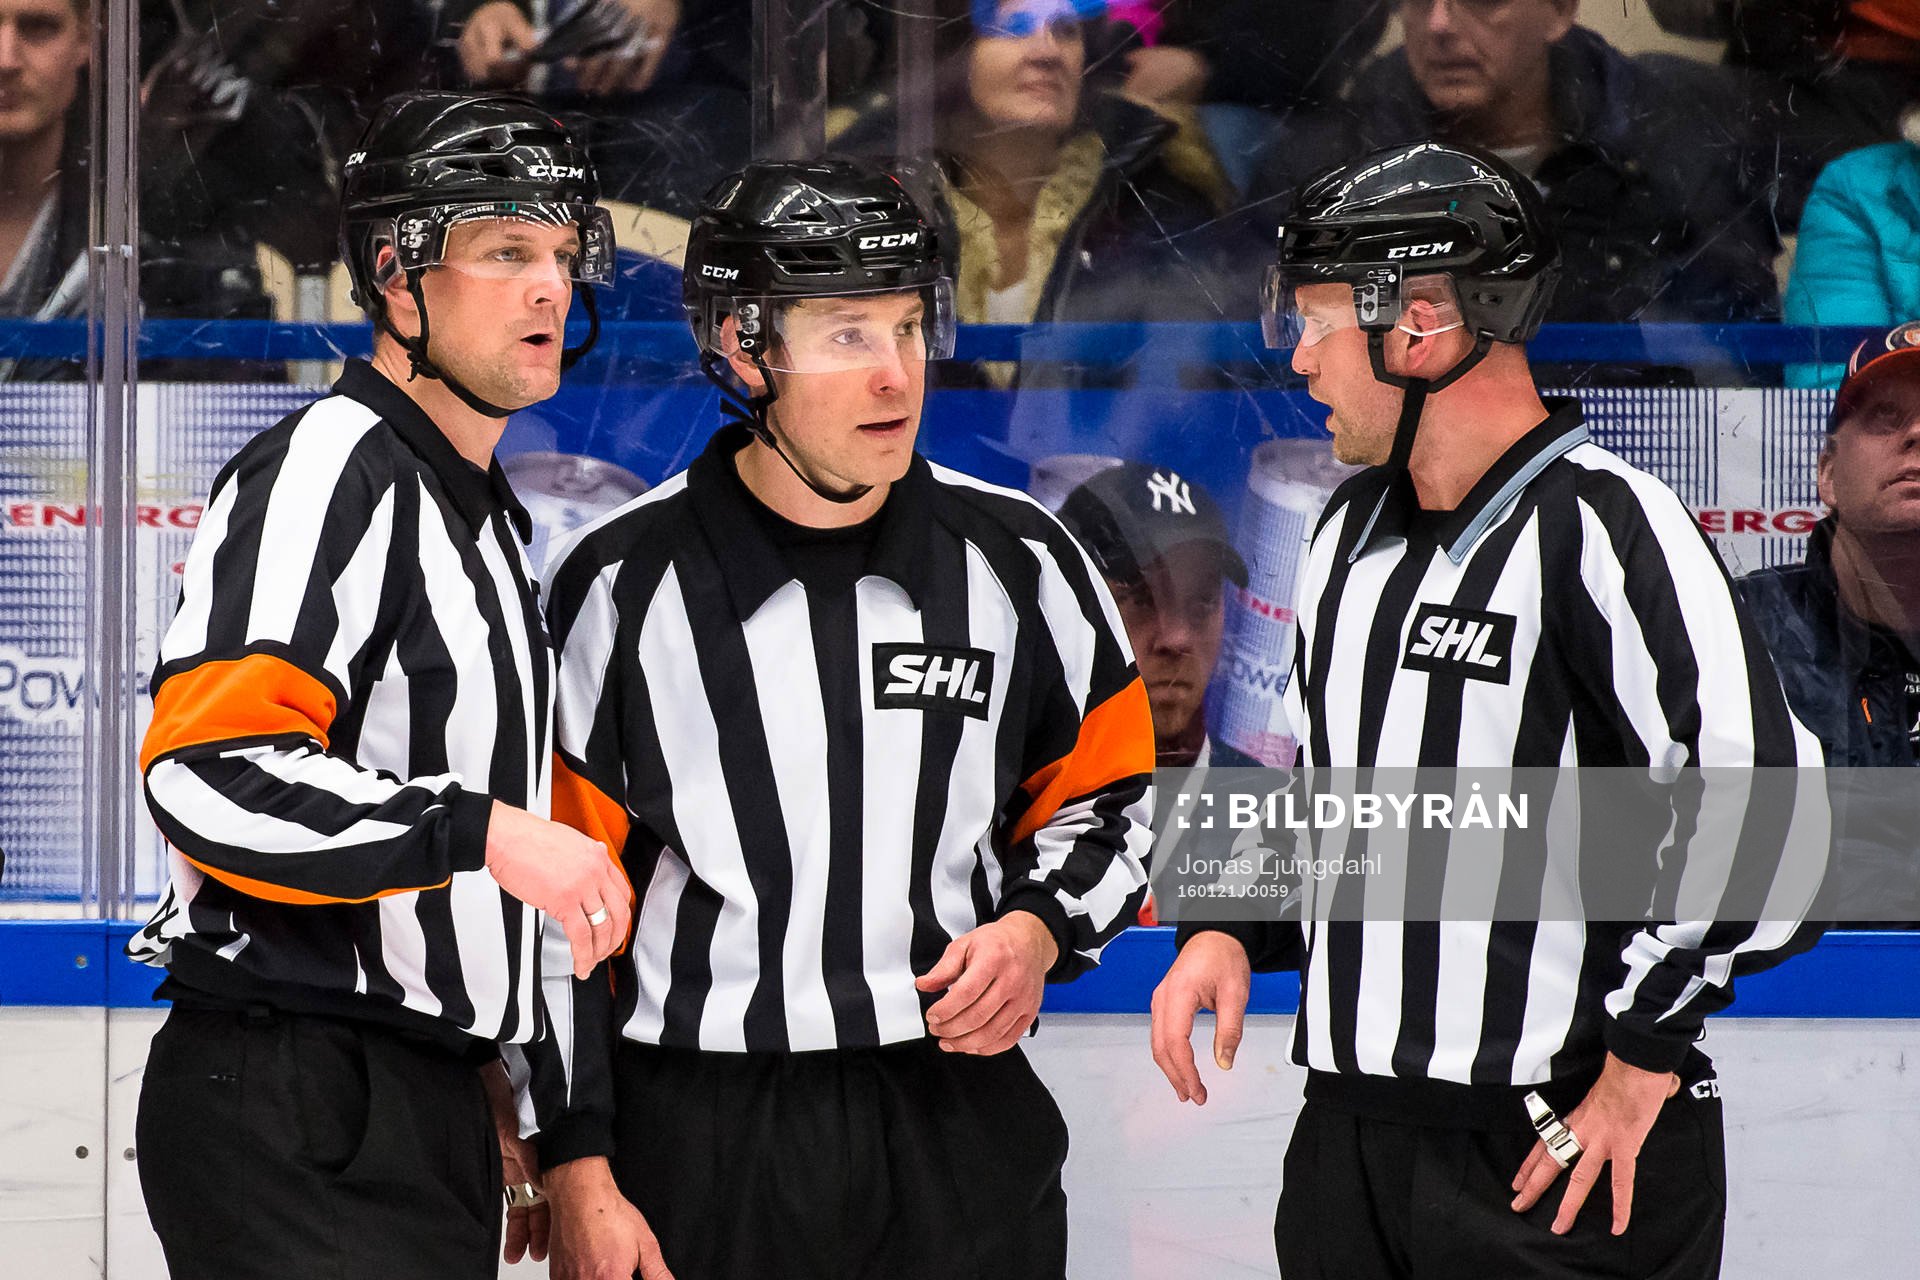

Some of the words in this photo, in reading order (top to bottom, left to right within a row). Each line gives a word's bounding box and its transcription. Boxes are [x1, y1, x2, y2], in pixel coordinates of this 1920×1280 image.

[528, 165, 584, 179] CCM
[858, 232, 918, 250] CCM
[1388, 241, 1454, 259] CCM
[702, 264, 739, 280] CCM
[1409, 615, 1503, 668] SHL
[884, 654, 987, 704] SHL
